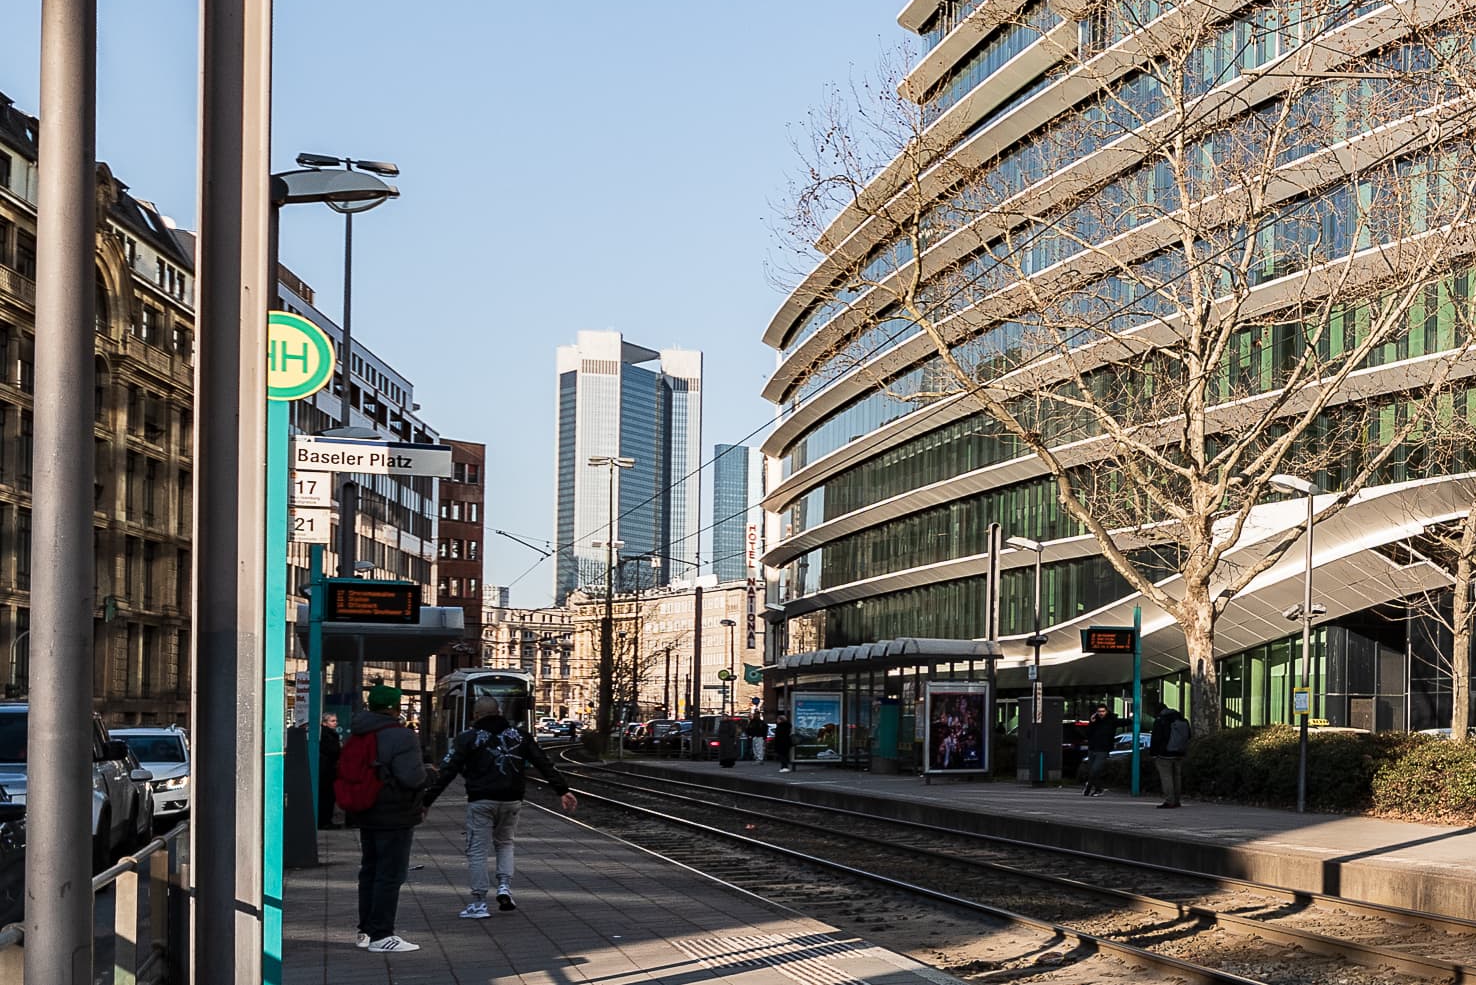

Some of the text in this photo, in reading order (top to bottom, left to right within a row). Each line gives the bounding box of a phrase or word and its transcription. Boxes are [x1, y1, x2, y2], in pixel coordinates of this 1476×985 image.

[297, 448, 412, 468] Baseler Platz
[295, 480, 317, 494] 17
[294, 517, 314, 532] 21
[747, 526, 757, 649] HOTEL NATIONAL
